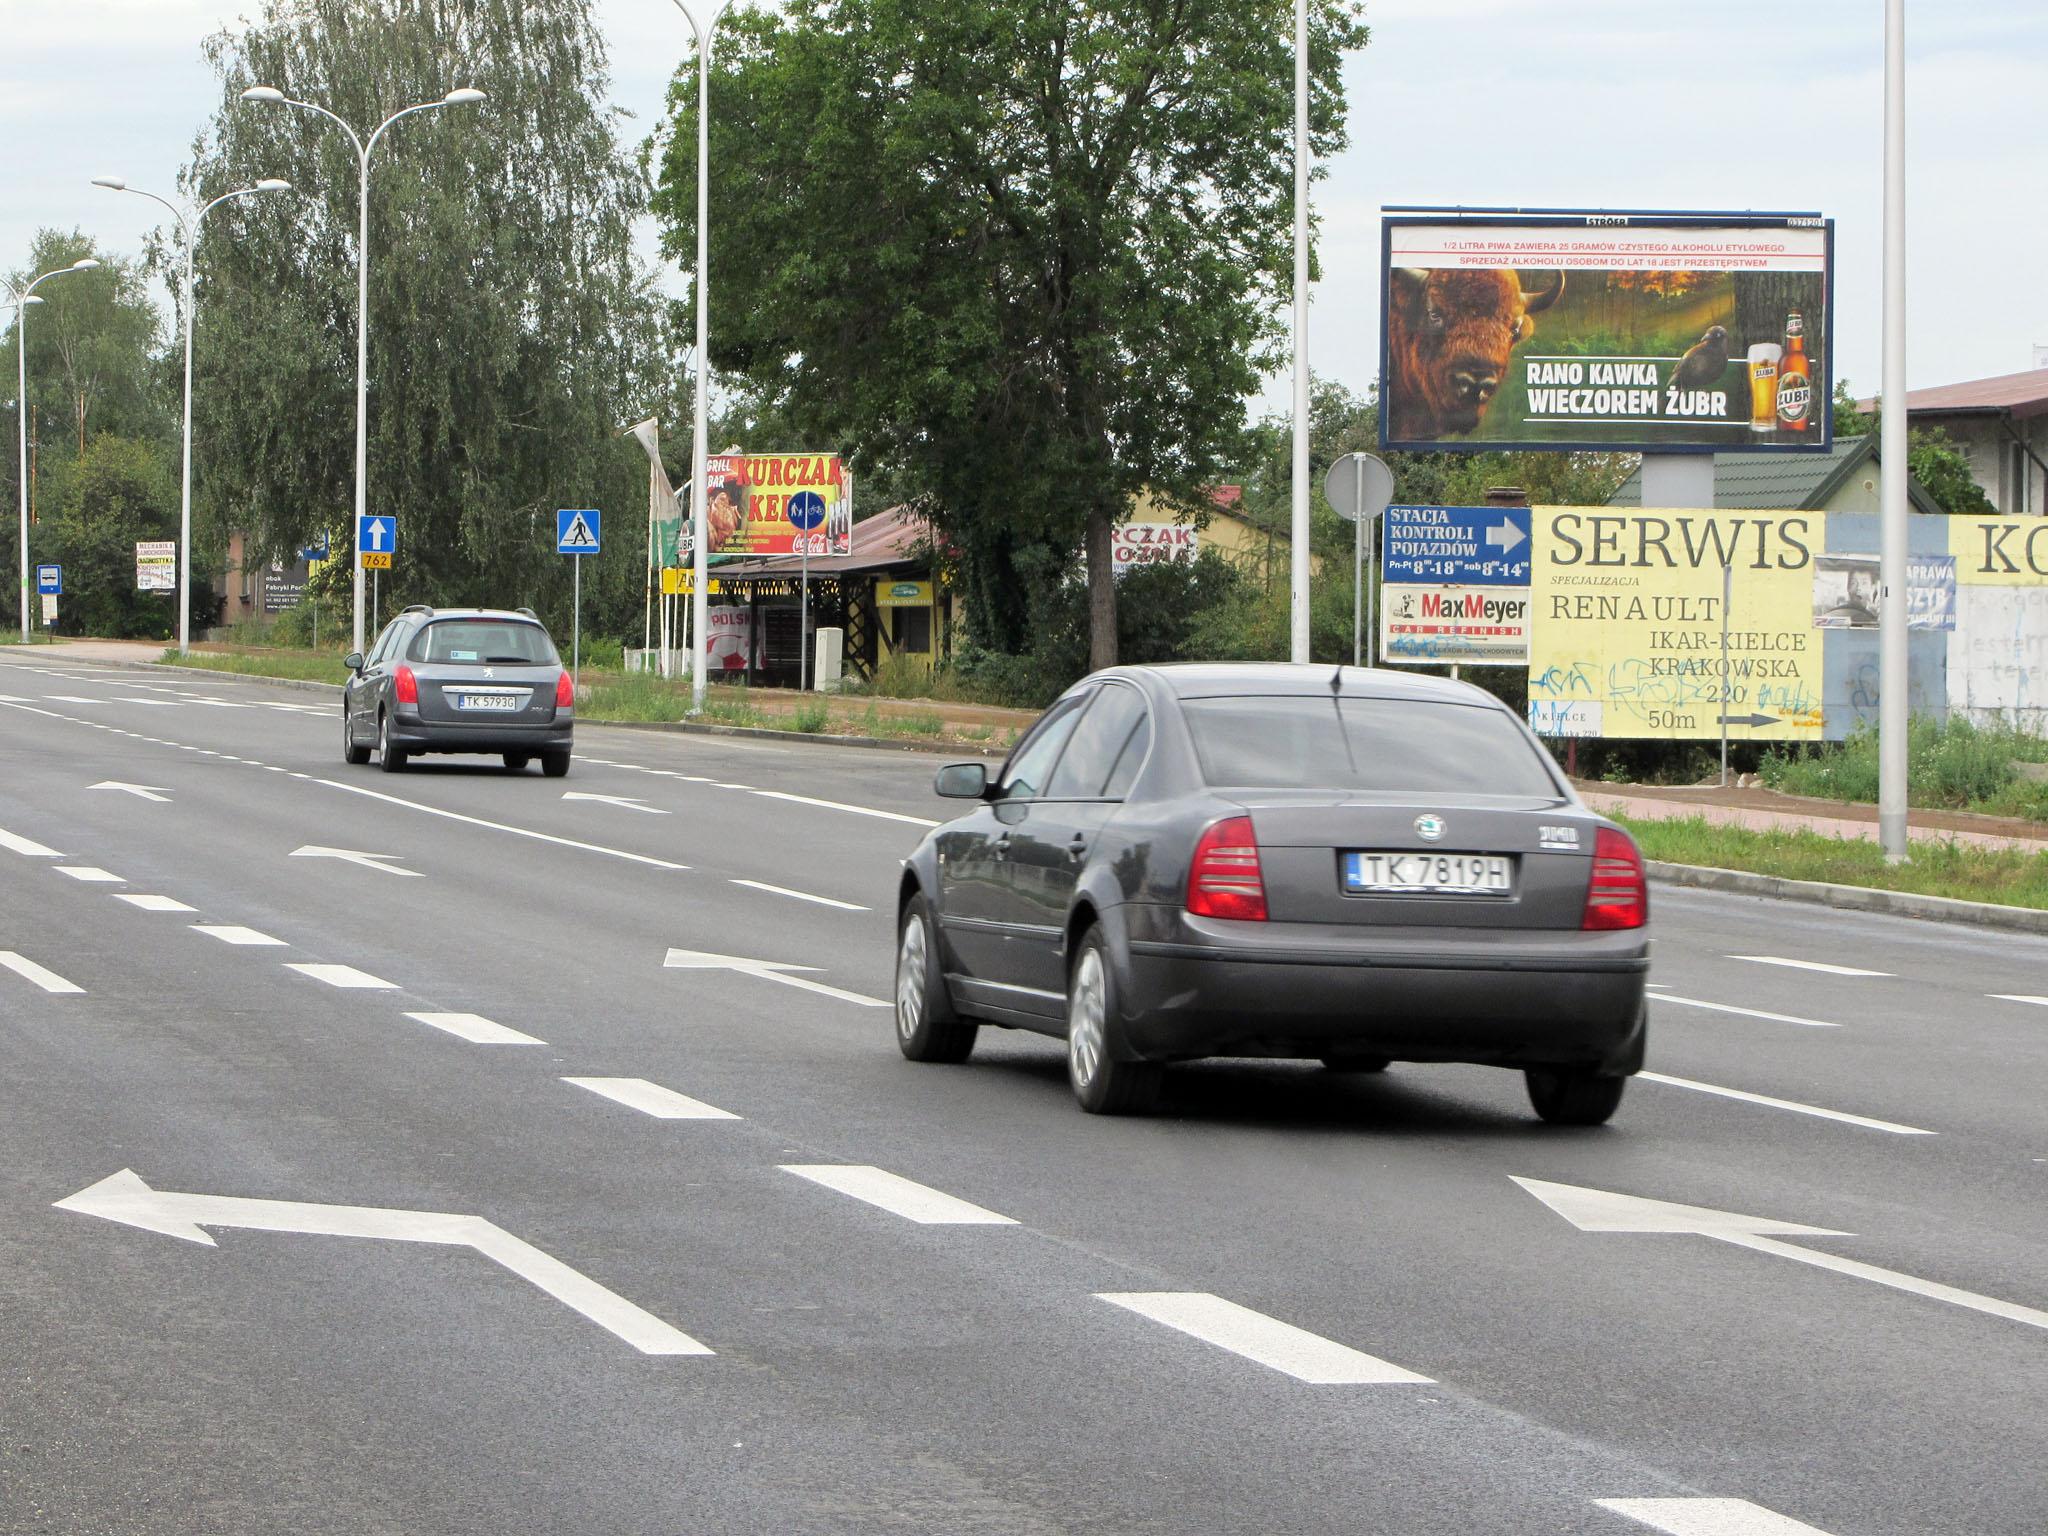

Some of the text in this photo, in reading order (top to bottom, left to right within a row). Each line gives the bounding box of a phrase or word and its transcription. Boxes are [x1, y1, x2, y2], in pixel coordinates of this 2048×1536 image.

[1588, 218, 1626, 226] STRÖER
[1443, 242, 1457, 250] 1/2
[1459, 242, 1485, 250] LITRA
[1487, 242, 1511, 250] PIWA
[1514, 242, 1556, 250] ZAWIERA
[1571, 241, 1616, 251] GRAMÓW
[1618, 243, 1668, 252] CZYSTEGO
[1671, 244, 1723, 252] ALKOHOLU
[1725, 244, 1785, 253] ETYLOWEGO
[1459, 255, 1509, 265] SPRZEDAŻ
[1511, 257, 1564, 266] ALKOHOLU
[1566, 258, 1608, 266] OSOBOM
[1610, 258, 1625, 266] DO
[1658, 259, 1681, 267] JEST
[1684, 259, 1768, 268] PRZESTĘPSTWEM
[1527, 363, 1658, 386] RANO KAWKA
[1527, 385, 1727, 416] WIECZOREM ŻUBR
[707, 457, 843, 486] GRILL KURCZAK
[707, 475, 724, 488] BAR
[1390, 508, 1450, 525] STACJA
[1111, 528, 1191, 544] RCZAK
[1390, 525, 1473, 541] KONTROLI
[1550, 513, 1810, 570] SERWIS
[1390, 540, 1478, 558] POJAZDÓW
[366, 555, 387, 566] 762
[1389, 560, 1412, 569] Pn-Pt
[1464, 561, 1481, 571] sob
[1550, 575, 1640, 587] SPECJALIZACJA
[1421, 593, 1527, 624] MaxMeyer
[1550, 595, 1720, 622] RENAULT
[1392, 625, 1520, 635] CAR REFINISH
[1649, 631, 1806, 652] IKAR-KIELCE
[1649, 657, 1801, 678] KRAKOWSKA
[466, 696, 514, 708] TK 5793G
[1705, 684, 1747, 704] 220
[1541, 712, 1586, 721] KIELCE
[1648, 710, 1697, 730] 50m
[1366, 856, 1505, 887] TK 7819H
